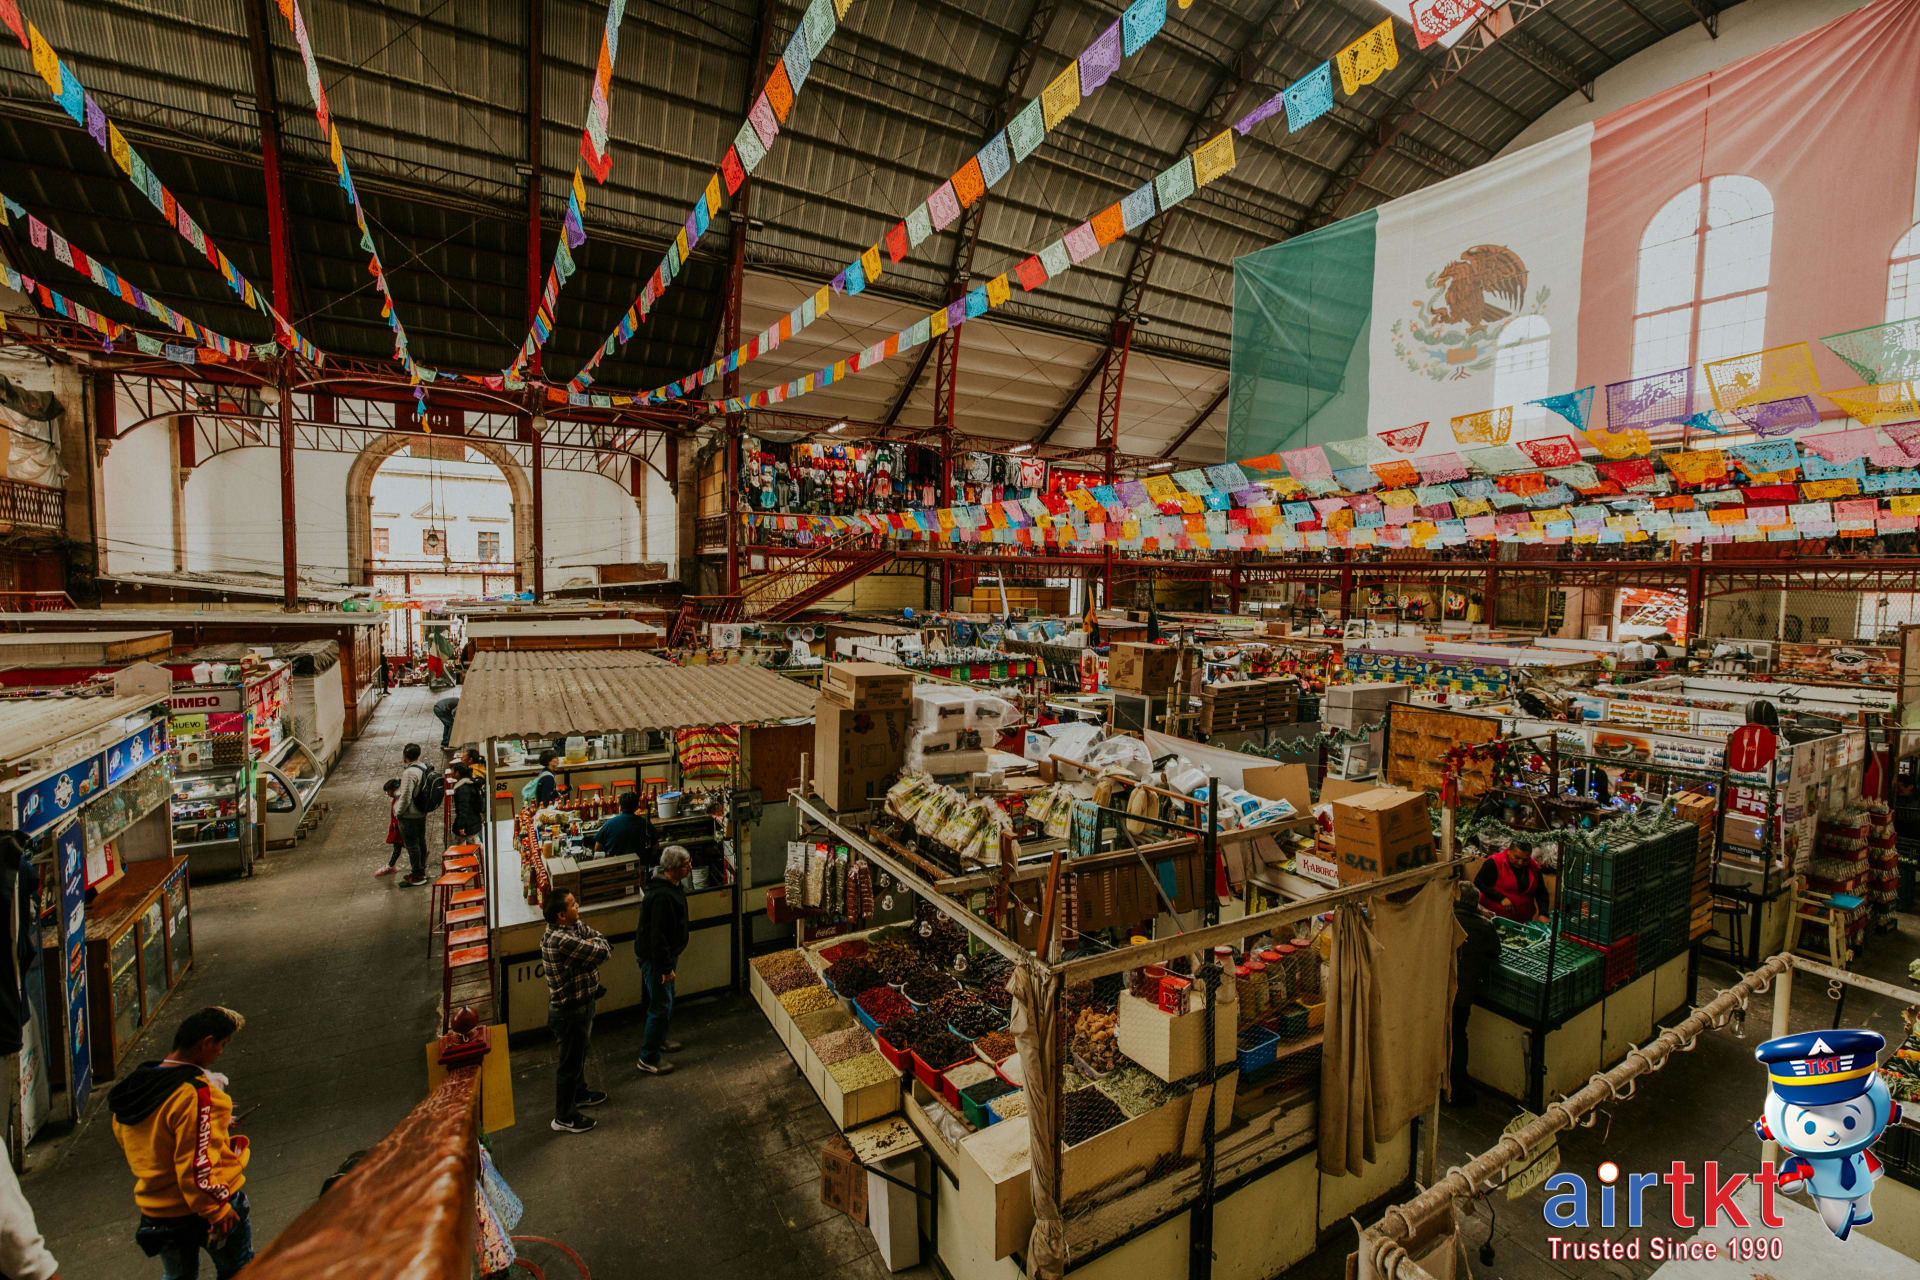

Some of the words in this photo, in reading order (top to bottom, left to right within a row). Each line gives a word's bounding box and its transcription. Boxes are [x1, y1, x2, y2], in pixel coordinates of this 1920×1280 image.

[160, 696, 220, 709] BIMBO
[172, 721, 200, 729] HUEVO
[22, 793, 40, 824] FUD
